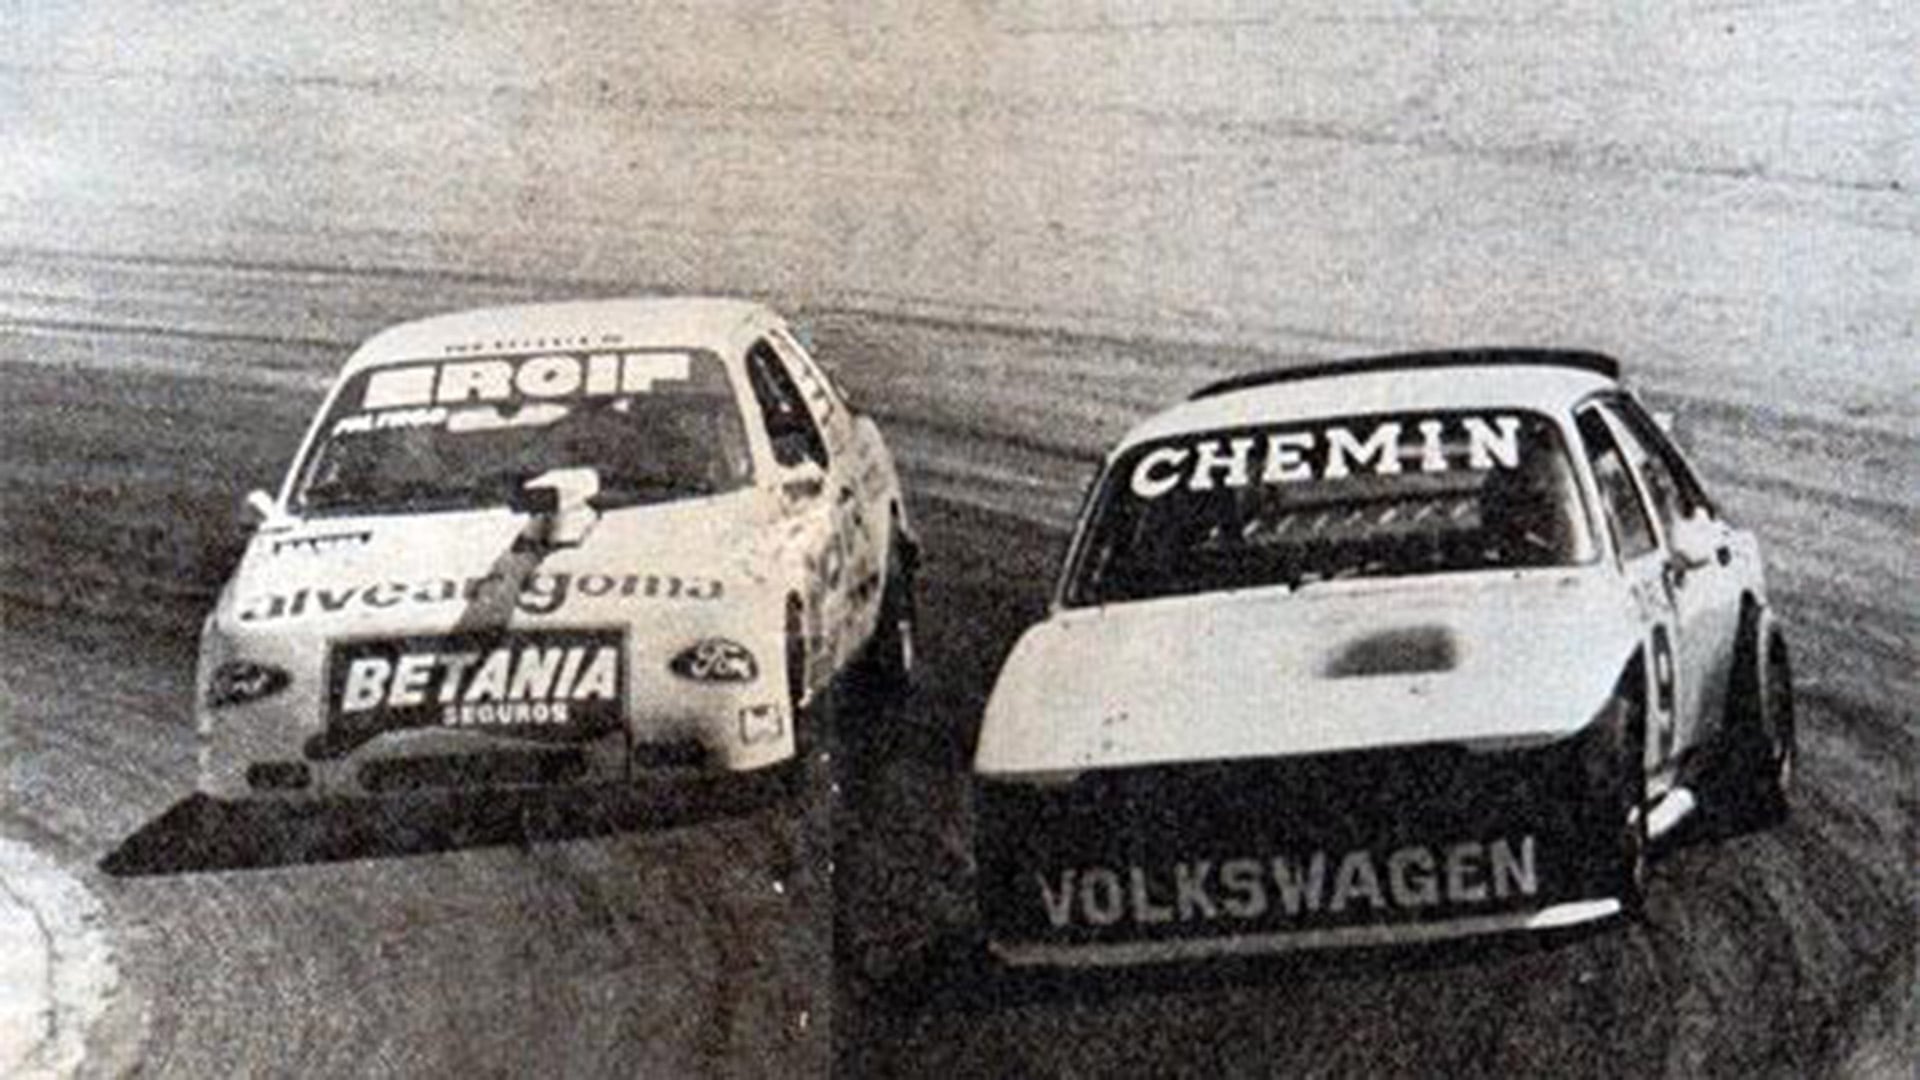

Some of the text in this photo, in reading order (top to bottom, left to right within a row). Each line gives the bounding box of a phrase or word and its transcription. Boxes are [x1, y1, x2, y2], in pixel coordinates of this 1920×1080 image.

[1130, 414, 1521, 499] CHEMIN
[513, 571, 725, 615] goma
[342, 645, 619, 712] BETANIA
[443, 701, 569, 726] SEGUROS
[1037, 835, 1540, 928] VOLKSWAGEN
